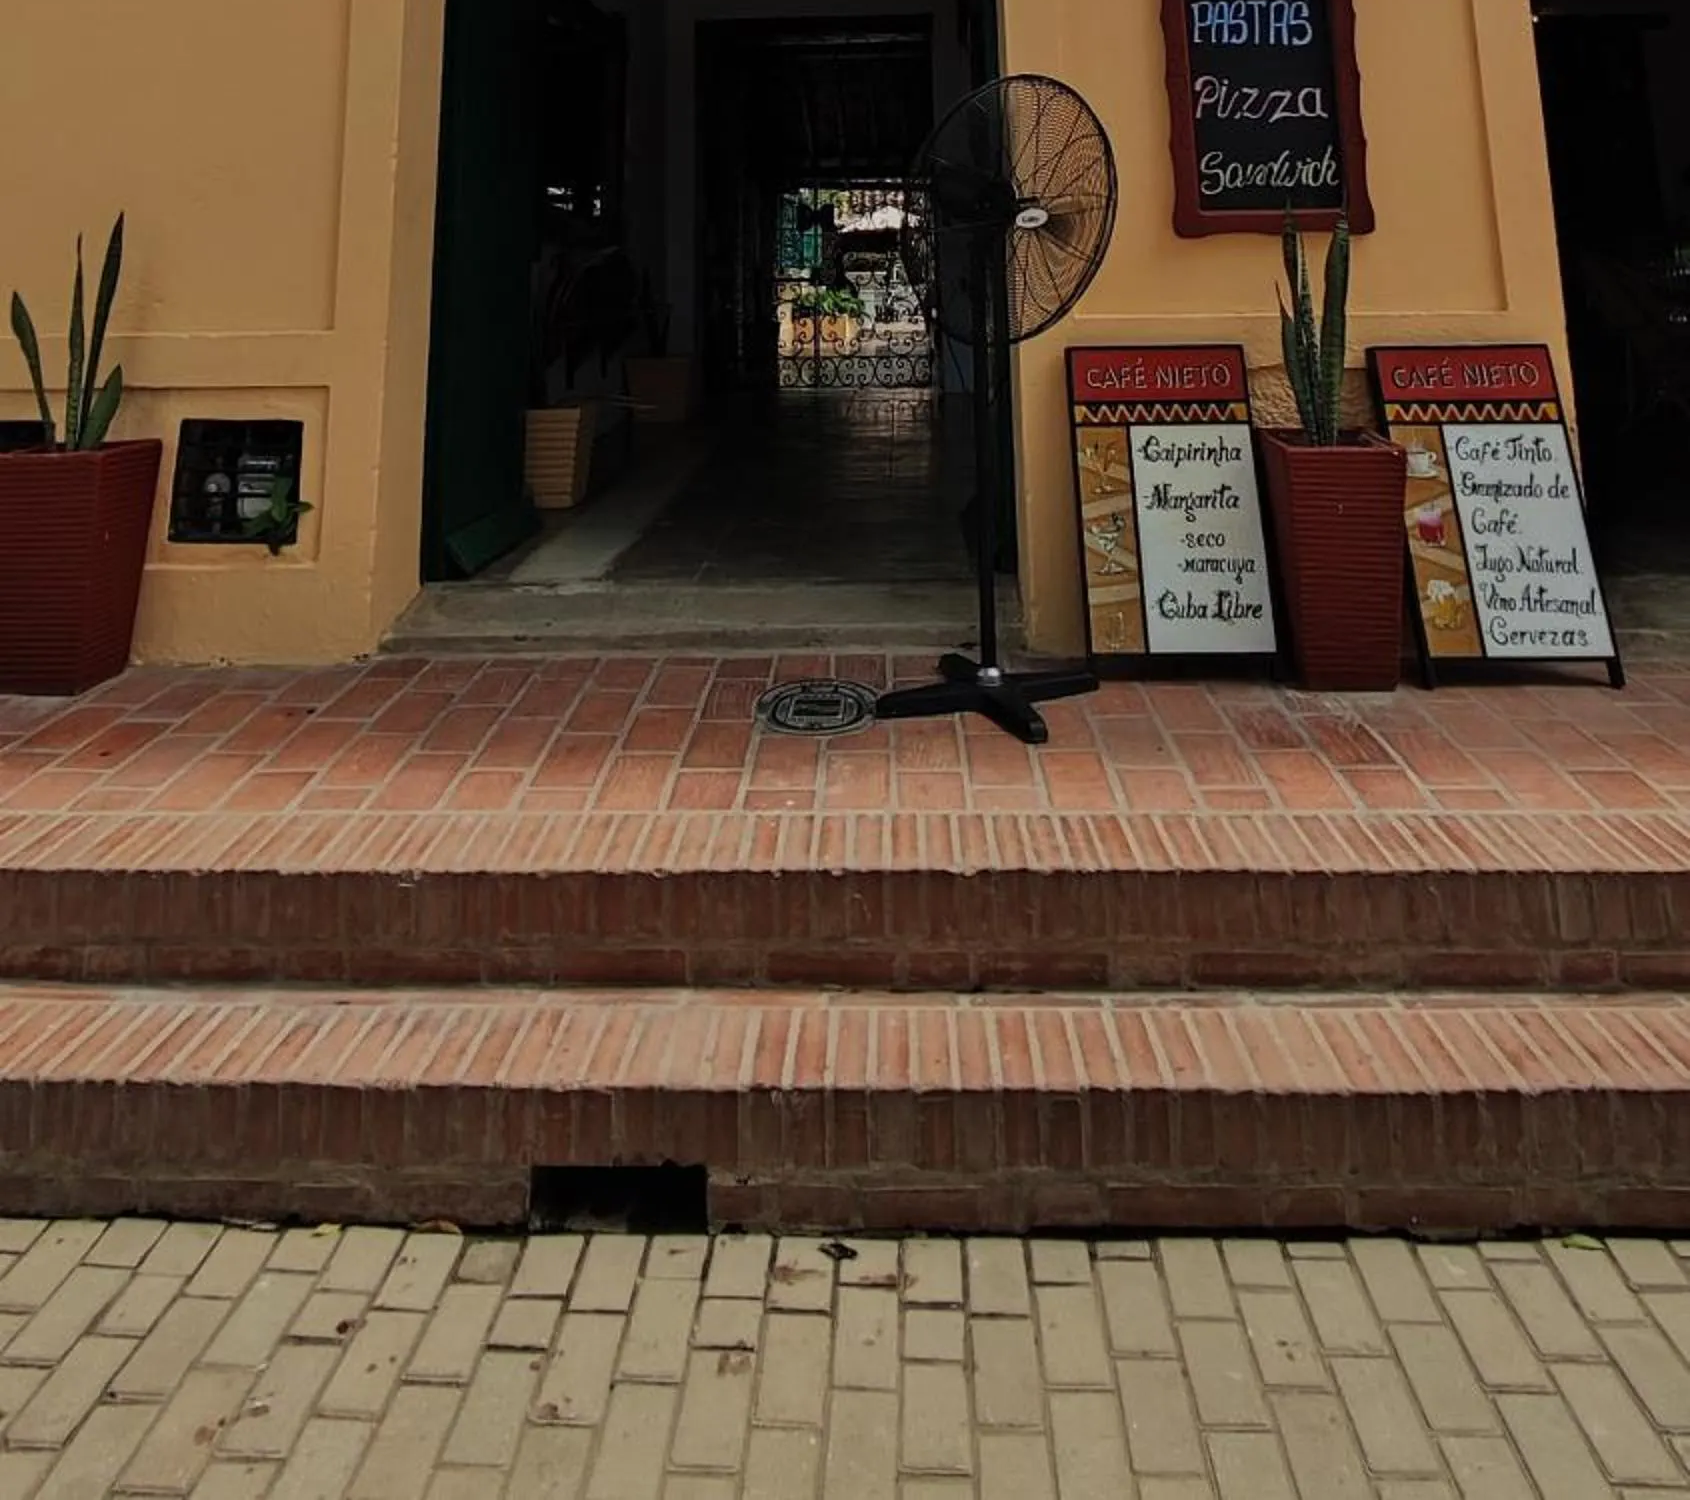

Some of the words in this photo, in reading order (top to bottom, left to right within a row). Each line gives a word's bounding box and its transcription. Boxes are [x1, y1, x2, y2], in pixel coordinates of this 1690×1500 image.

[1190, 0, 1313, 45] PASTAS
[1194, 75, 1329, 123] Pizza
[1200, 144, 1340, 195] Sandwich
[1087, 357, 1147, 389] CAFÉ
[1156, 363, 1231, 389] NIETO
[1392, 356, 1456, 389] CAFÉ
[1463, 361, 1540, 389] NIETO
[1455, 435, 1501, 463] Café
[1547, 473, 1570, 498] de
[1474, 544, 1514, 582] Jugo
[1159, 588, 1208, 619] Cuba
[1479, 581, 1516, 611] Vino
[1489, 615, 1589, 646] Cervezas
